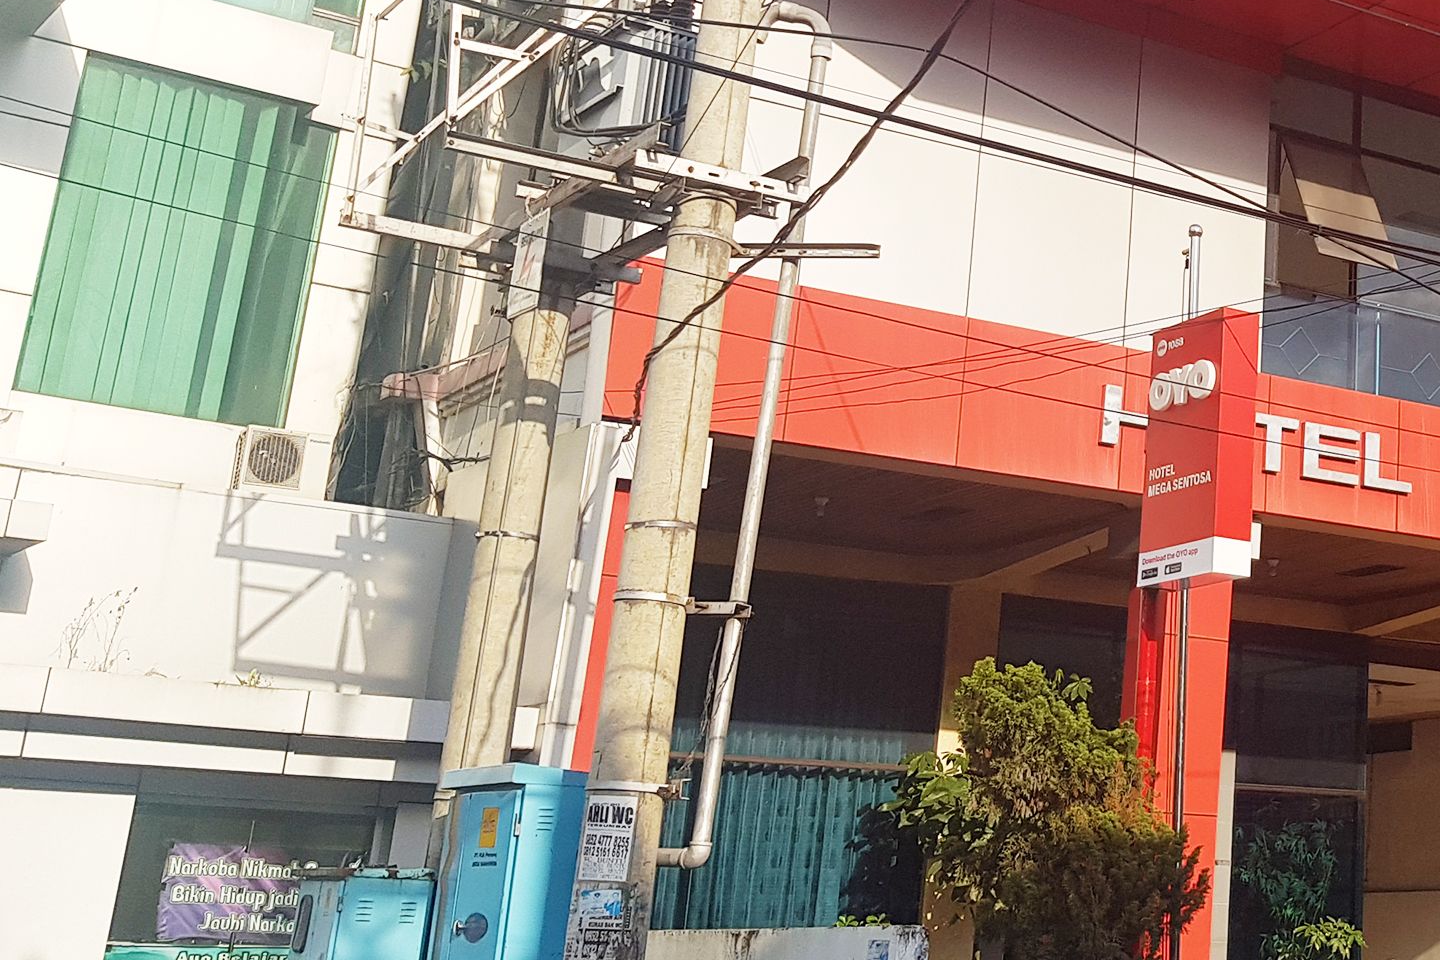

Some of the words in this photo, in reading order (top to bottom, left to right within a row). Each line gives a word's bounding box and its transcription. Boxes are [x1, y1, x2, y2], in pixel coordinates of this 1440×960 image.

[1148, 358, 1217, 411] OYO
[1098, 384, 1413, 495] HTEL
[1148, 463, 1176, 481] HOTEL
[1147, 480, 1172, 498] MEGA
[1172, 470, 1212, 491] SENTOSA
[1175, 548, 1188, 558] OYO
[611, 805, 634, 826] WC
[168, 856, 238, 877] Narkoba
[171, 885, 215, 903] Bikin
[219, 886, 265, 912] Hidup
[265, 887, 299, 911] jadi
[198, 912, 245, 931] Jauhi
